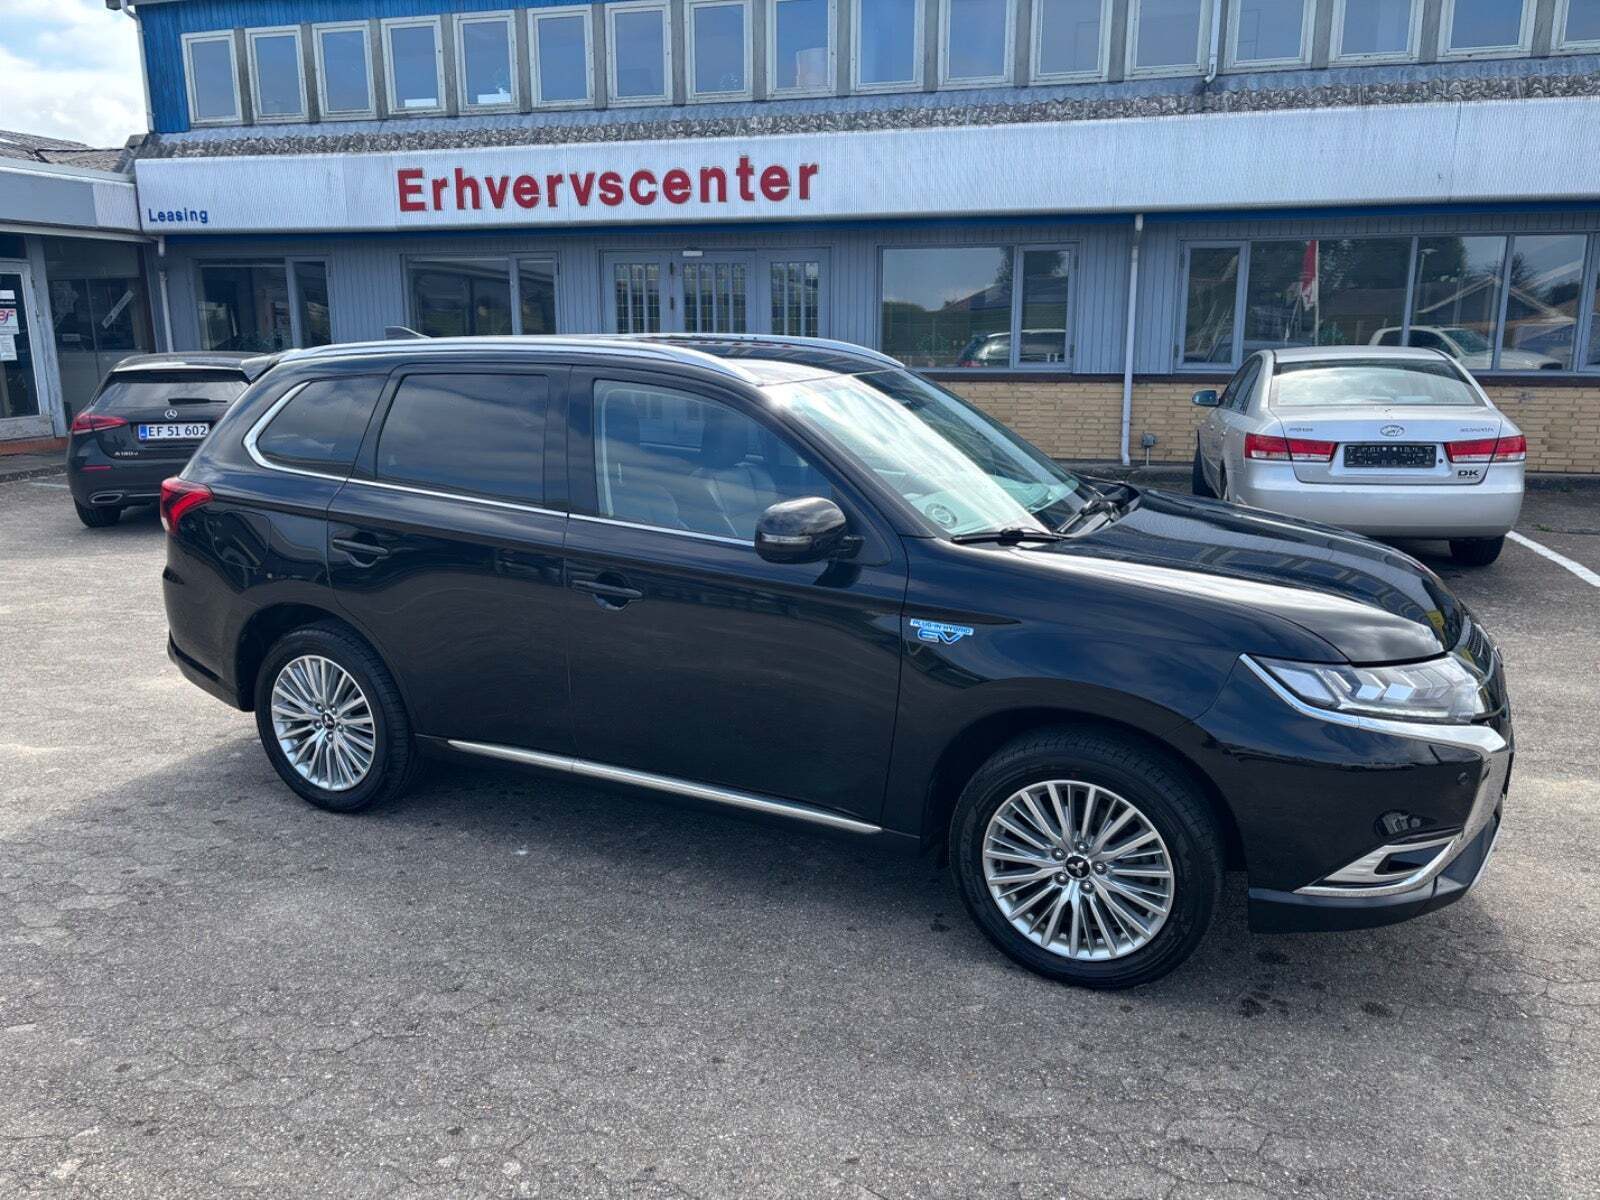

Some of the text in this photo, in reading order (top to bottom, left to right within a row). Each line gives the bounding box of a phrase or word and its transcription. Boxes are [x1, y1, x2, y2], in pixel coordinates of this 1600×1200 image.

[397, 155, 819, 213] Erhvervscenter
[148, 208, 208, 224] Leasing
[148, 424, 207, 437] EF 51 602
[1457, 469, 1479, 477] DK
[917, 628, 963, 645] EV
